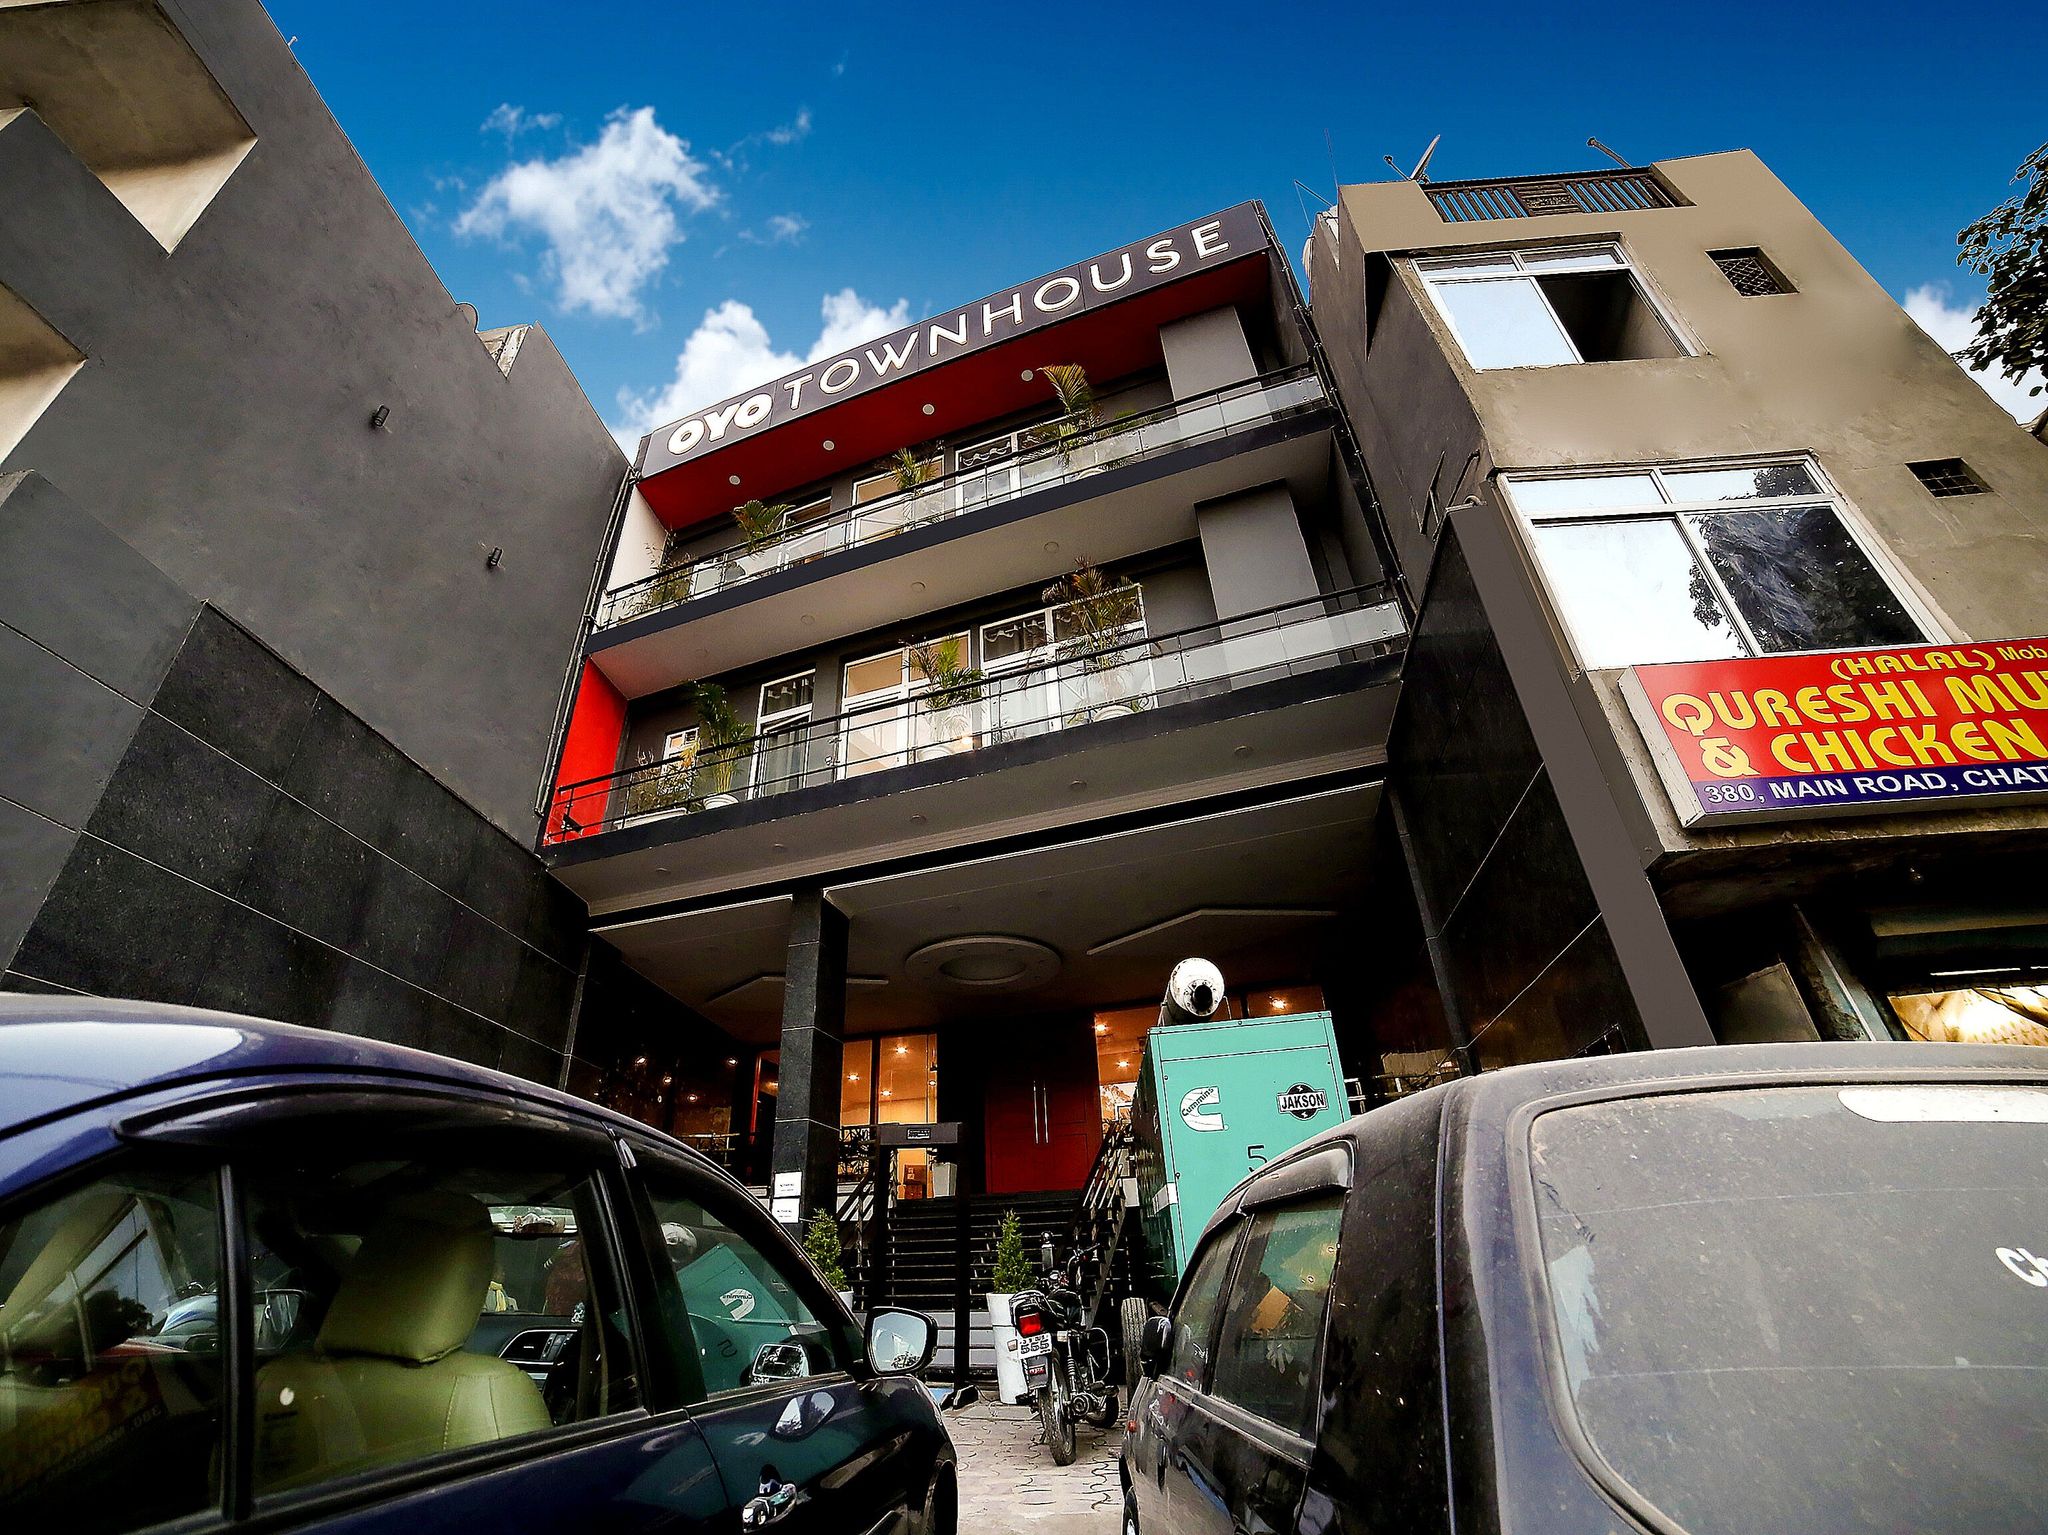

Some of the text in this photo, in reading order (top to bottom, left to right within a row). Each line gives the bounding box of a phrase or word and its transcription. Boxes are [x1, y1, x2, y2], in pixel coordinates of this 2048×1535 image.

[667, 220, 1231, 455] OYO TOWNHOUSE
[1830, 649, 1996, 681] (HALAL)
[1661, 670, 2048, 736] QURESHI MU
[1699, 718, 2048, 777] & CHICKEN
[1704, 766, 2048, 804] 380, MAIN ROAD, CHAT
[1181, 1088, 1214, 1117] Cummins
[1281, 1093, 1325, 1110] JAKSON
